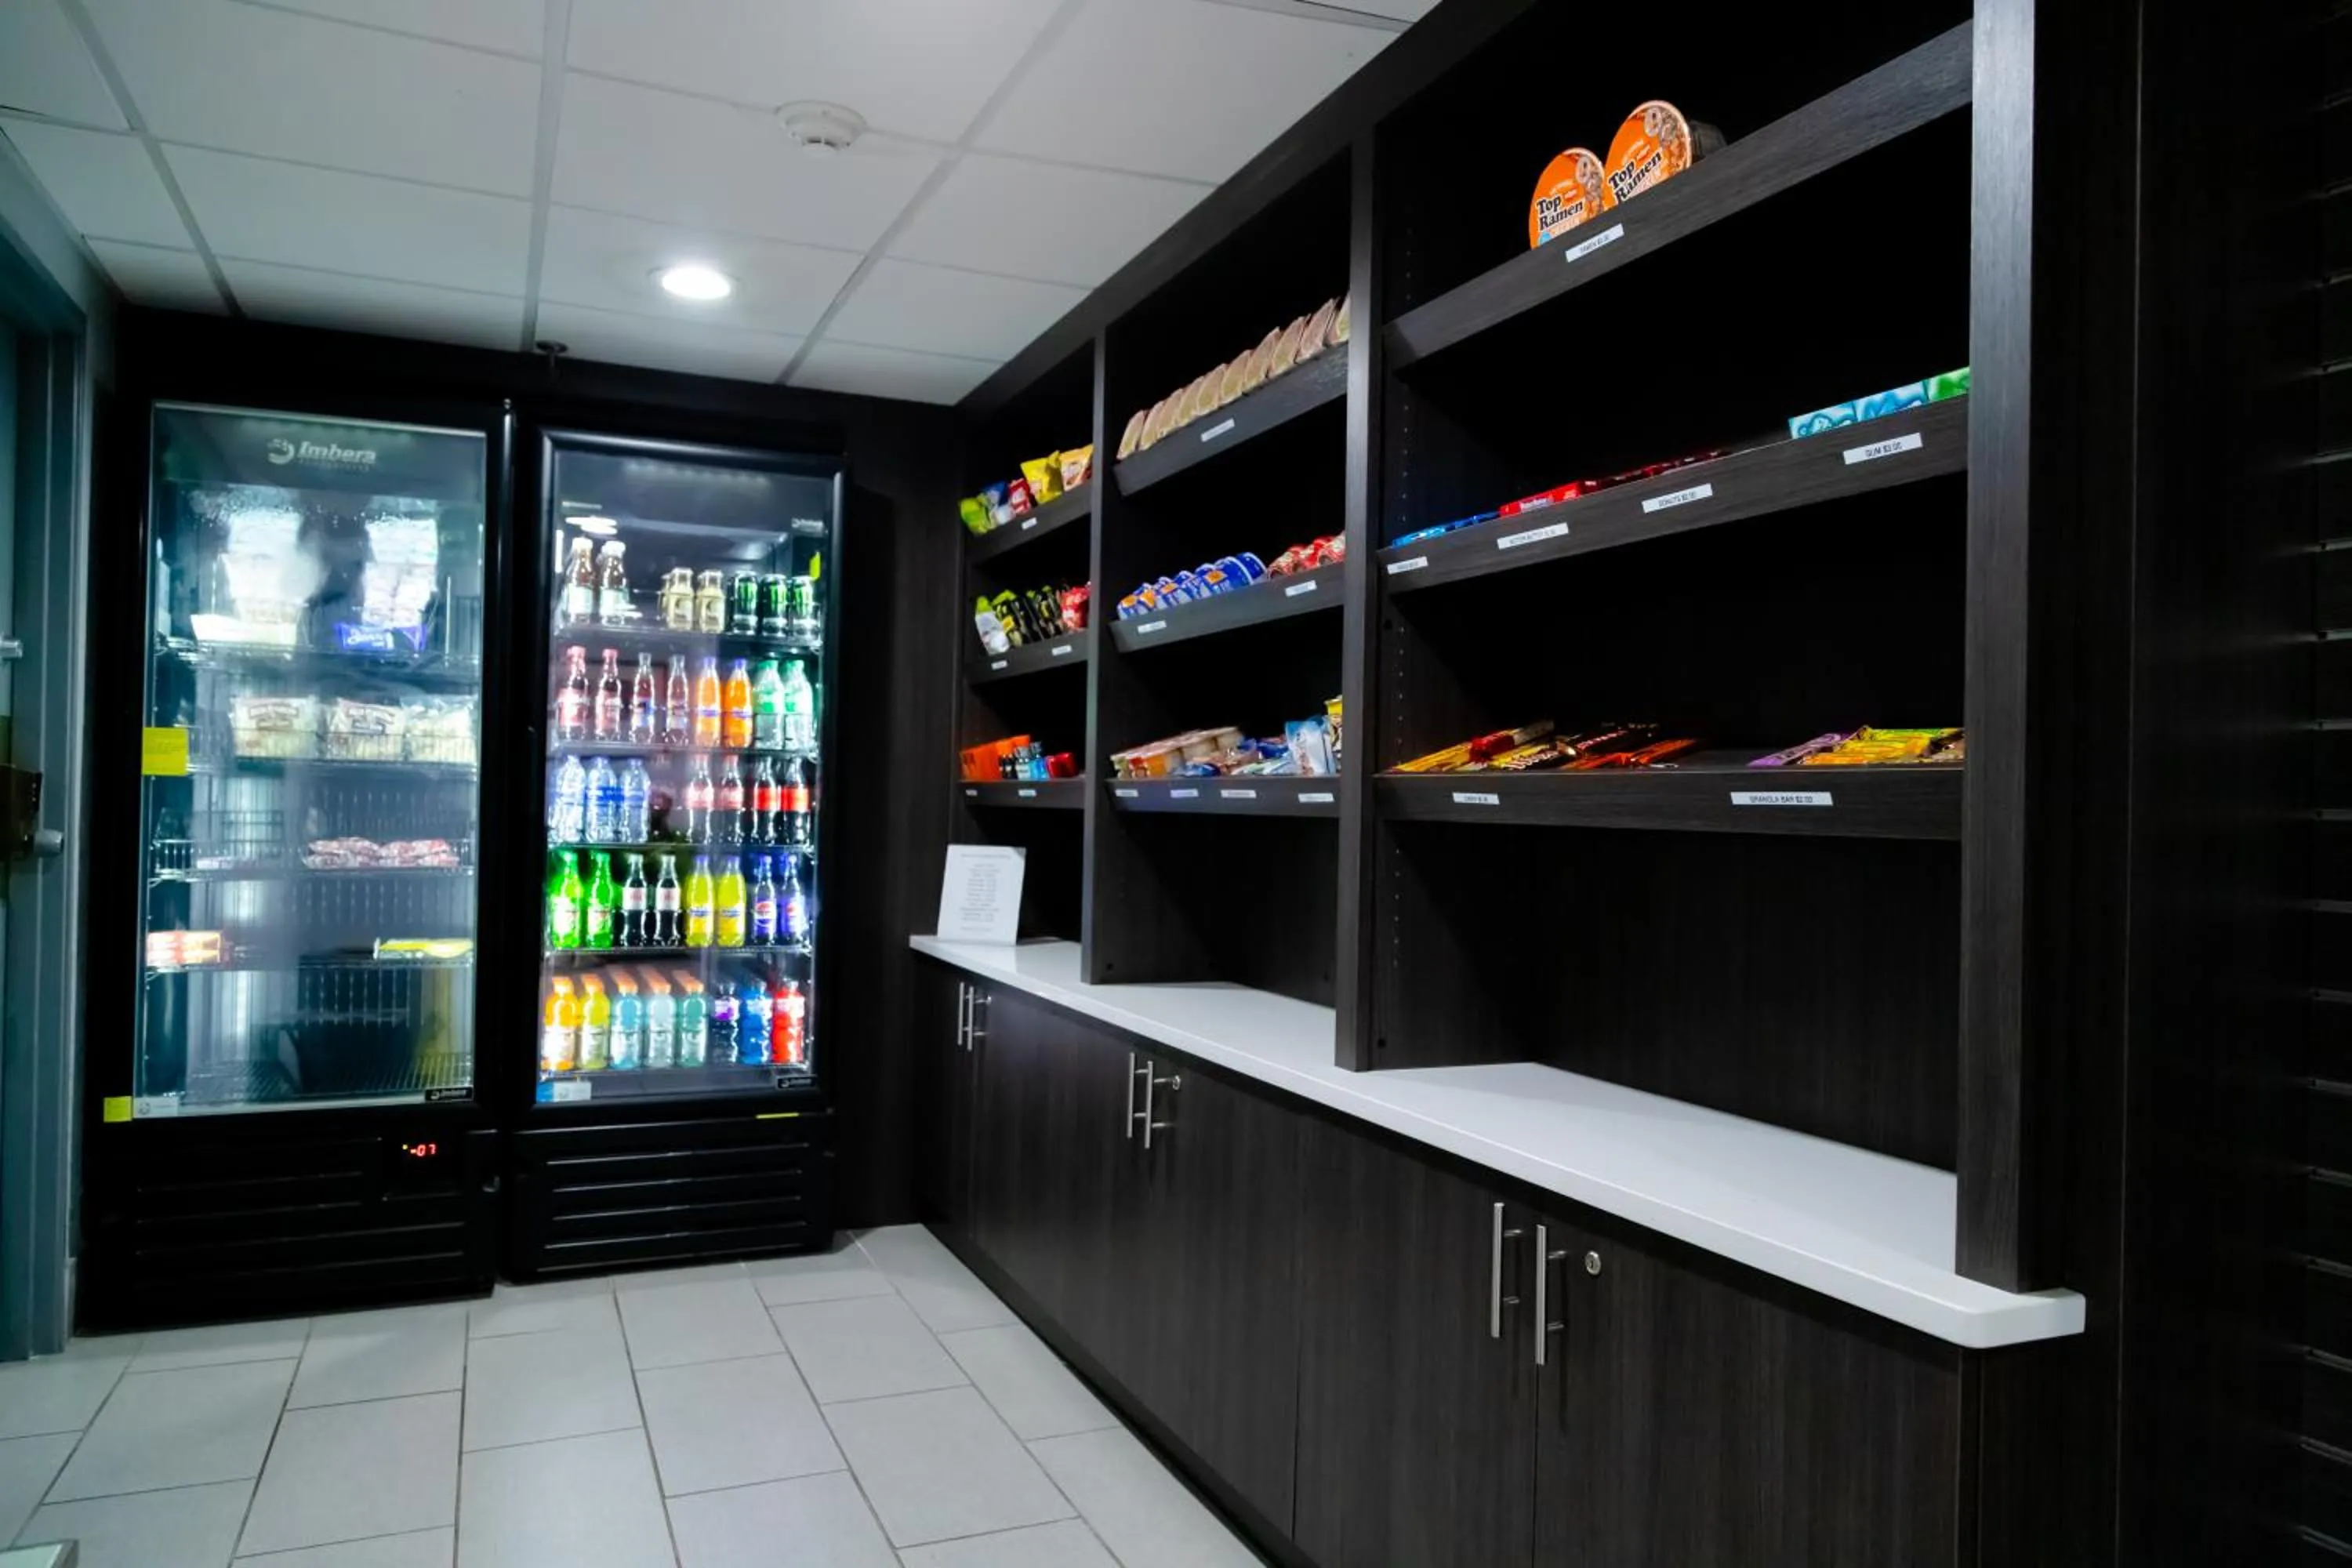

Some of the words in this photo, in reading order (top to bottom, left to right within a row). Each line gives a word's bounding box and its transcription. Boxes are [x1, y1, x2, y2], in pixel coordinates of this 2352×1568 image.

[1608, 161, 1635, 189] Top
[1616, 151, 1661, 204] Ramen
[1537, 195, 1561, 215] Top
[1540, 201, 1583, 231] Ramen
[296, 441, 376, 464] Imbera
